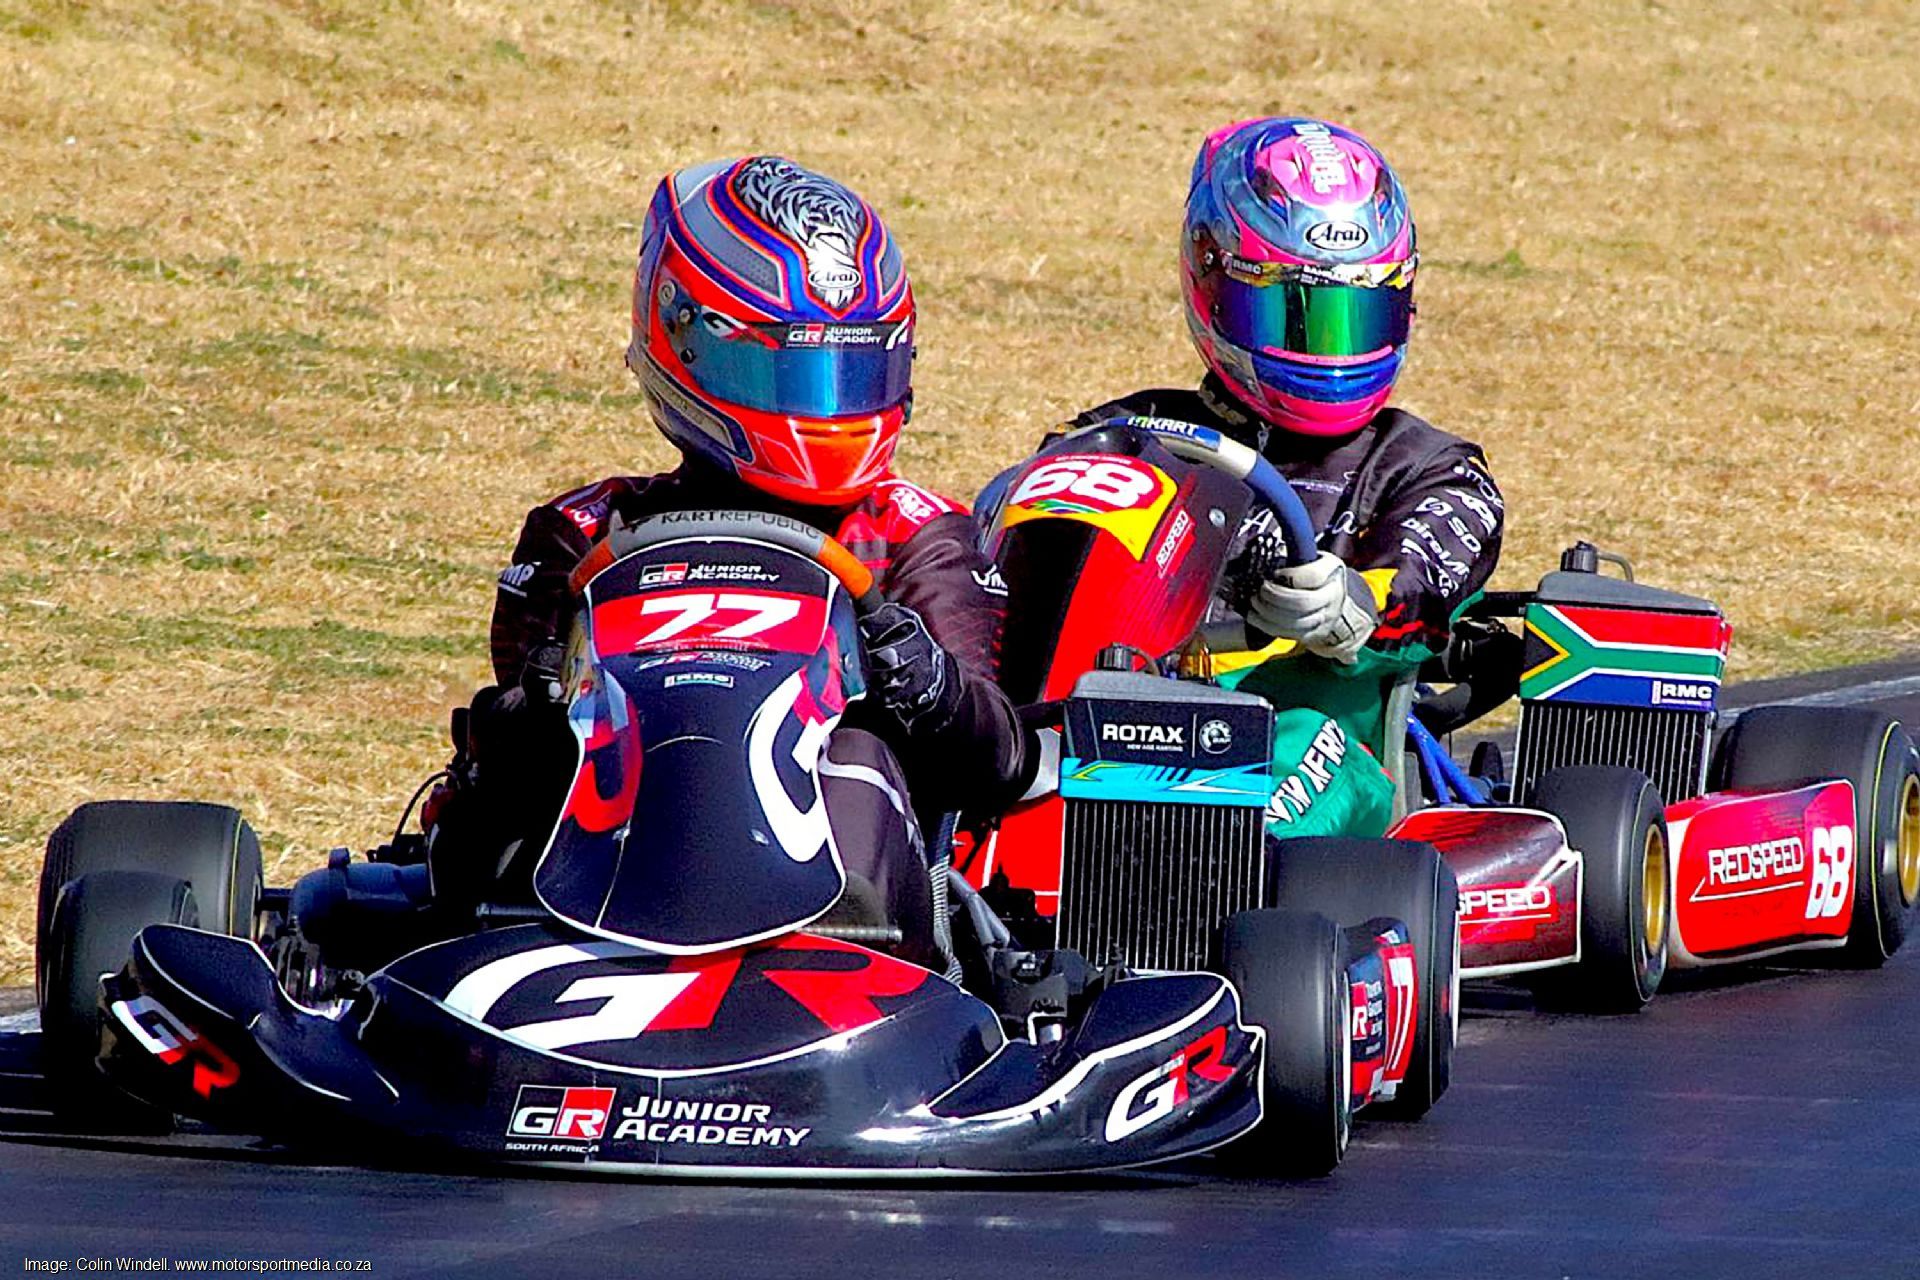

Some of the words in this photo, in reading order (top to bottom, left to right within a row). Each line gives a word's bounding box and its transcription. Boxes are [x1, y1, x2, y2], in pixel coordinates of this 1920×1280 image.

[1311, 224, 1361, 244] Arai
[790, 330, 821, 343] GR
[823, 335, 881, 344] ACADEMY
[827, 326, 873, 336] JUNIOR
[1009, 460, 1155, 508] 68
[641, 573, 686, 584] GR
[687, 572, 780, 582] ACADEMY
[692, 564, 762, 573] JUNIOR
[634, 593, 802, 646] 77
[1662, 683, 1713, 699] RMC
[1102, 723, 1184, 743] ROTAX
[1708, 837, 1804, 886] REDSPEED
[1805, 825, 1853, 919] 68
[1458, 885, 1551, 916] SPEED
[443, 932, 930, 1050] GR
[111, 995, 241, 1100] GR
[1104, 1024, 1237, 1142] GR
[511, 1106, 606, 1138] GR
[622, 1096, 771, 1124] JUNIOR
[613, 1118, 812, 1147] ACADEMY
[505, 1143, 548, 1152] SOUTH
[549, 1144, 600, 1153] AFRICA
